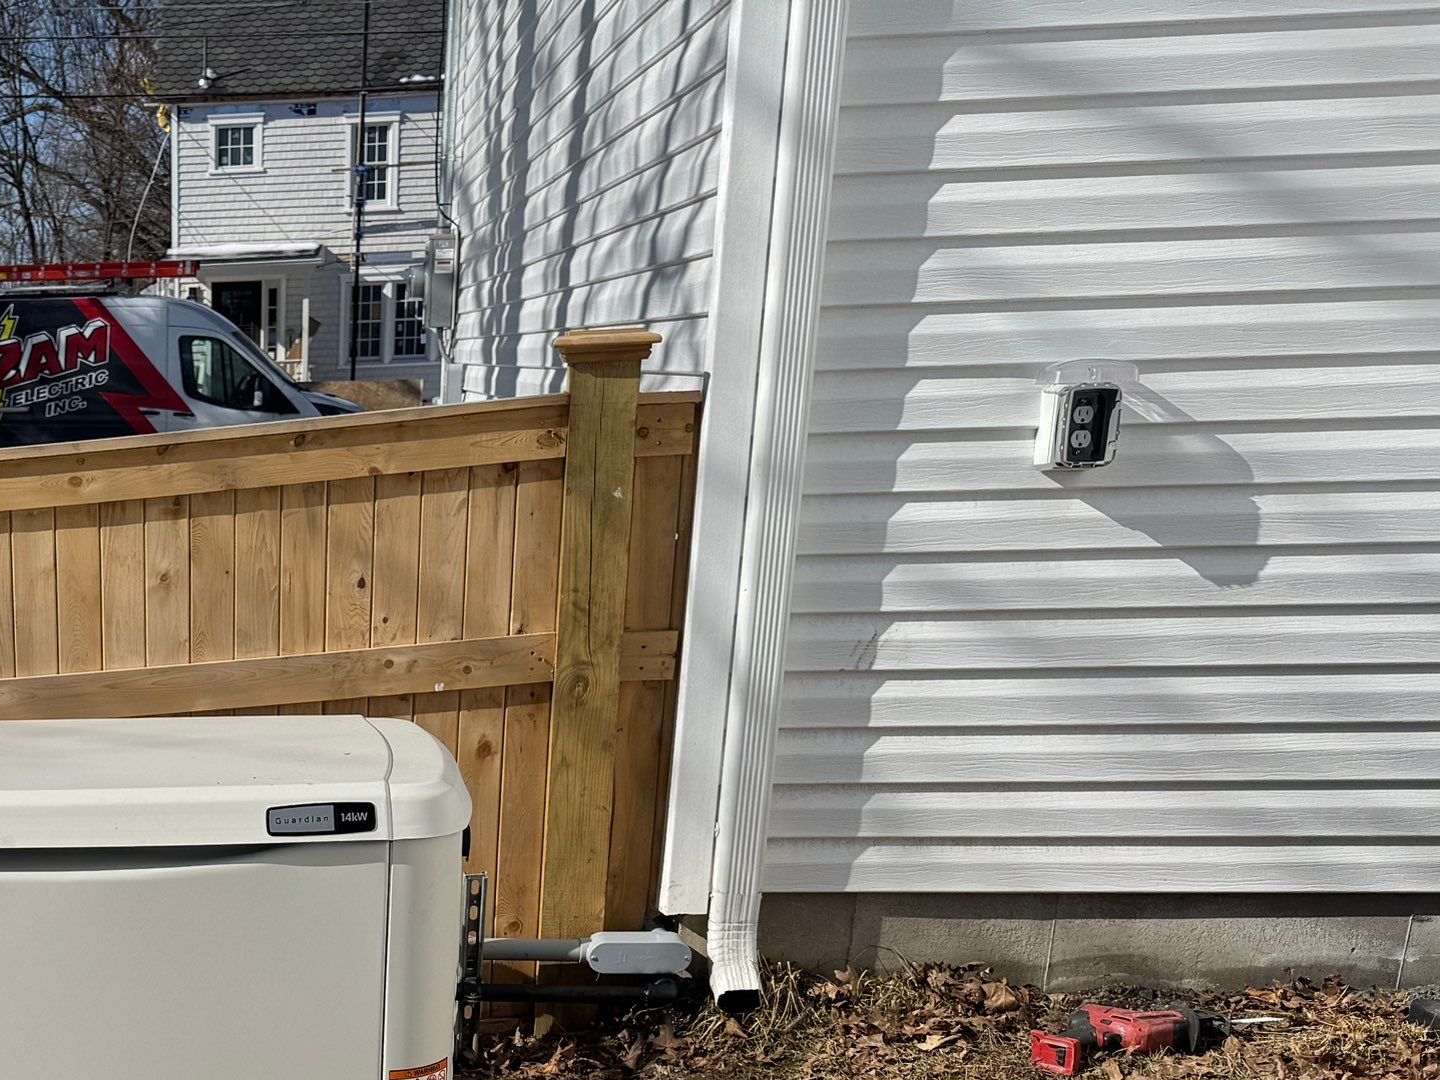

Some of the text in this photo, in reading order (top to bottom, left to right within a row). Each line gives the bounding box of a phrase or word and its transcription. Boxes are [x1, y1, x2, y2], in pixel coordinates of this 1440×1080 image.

[10, 369, 110, 408] ELECTRIC
[45, 396, 88, 417] INC.
[275, 811, 368, 825] Guardian 14kW
